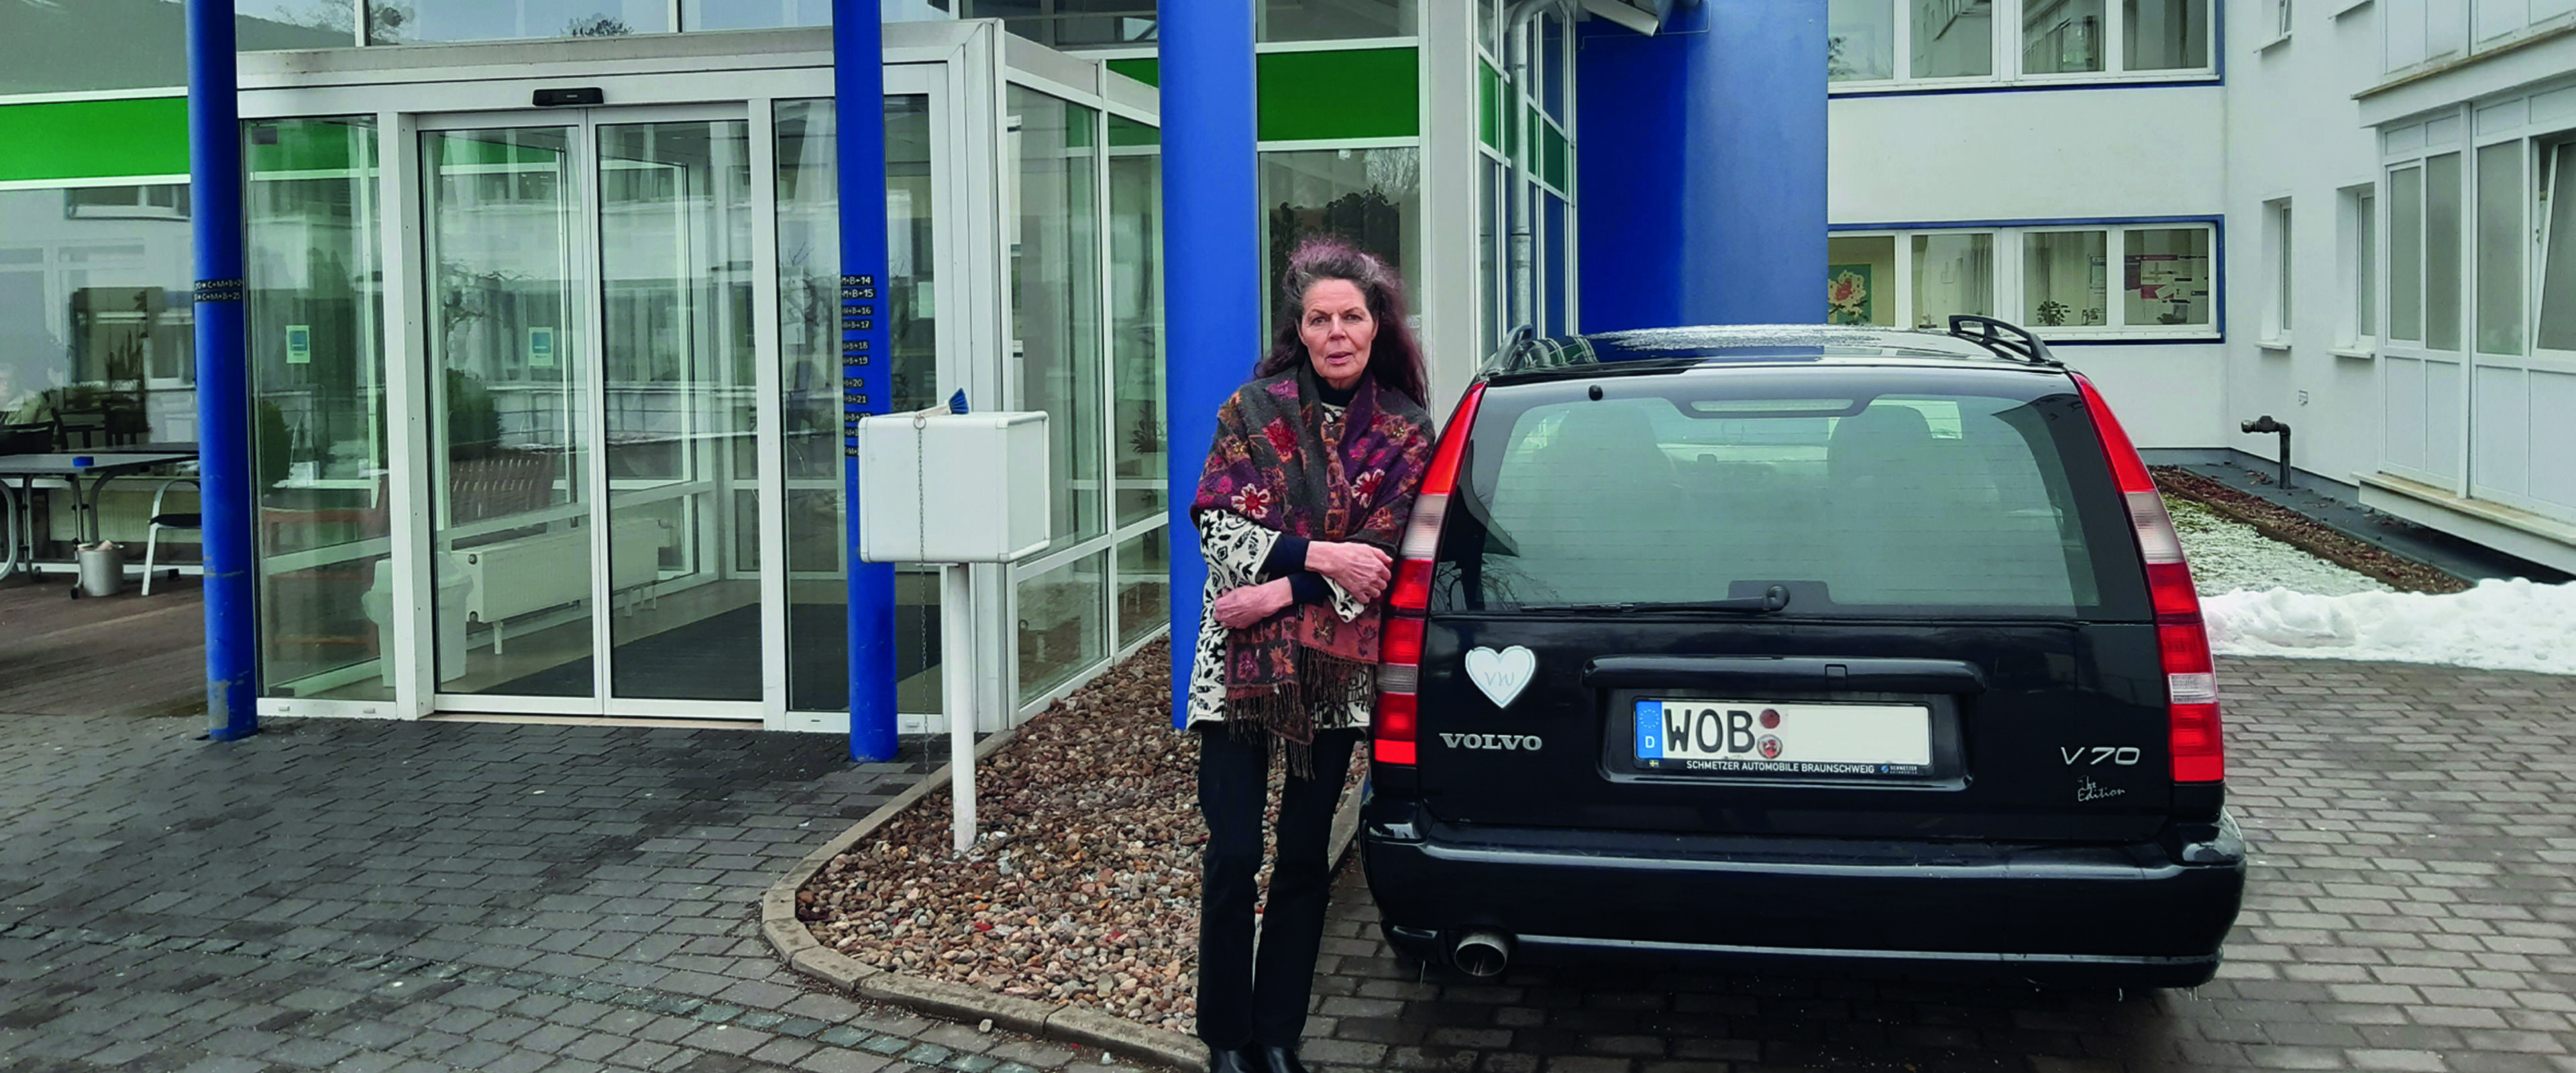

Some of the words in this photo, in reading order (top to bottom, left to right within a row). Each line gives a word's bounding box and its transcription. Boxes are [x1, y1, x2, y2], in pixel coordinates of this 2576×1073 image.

[1664, 709, 1756, 753] WOB
[1439, 732, 1542, 750] VOLVO
[1645, 736, 1655, 748] D
[1686, 760, 1739, 771] SCHMETZER
[1741, 761, 1800, 772] AUTOMOBILE
[1801, 763, 1874, 774] BRAUNSCHWEIG
[2078, 787, 2125, 801] Edition
